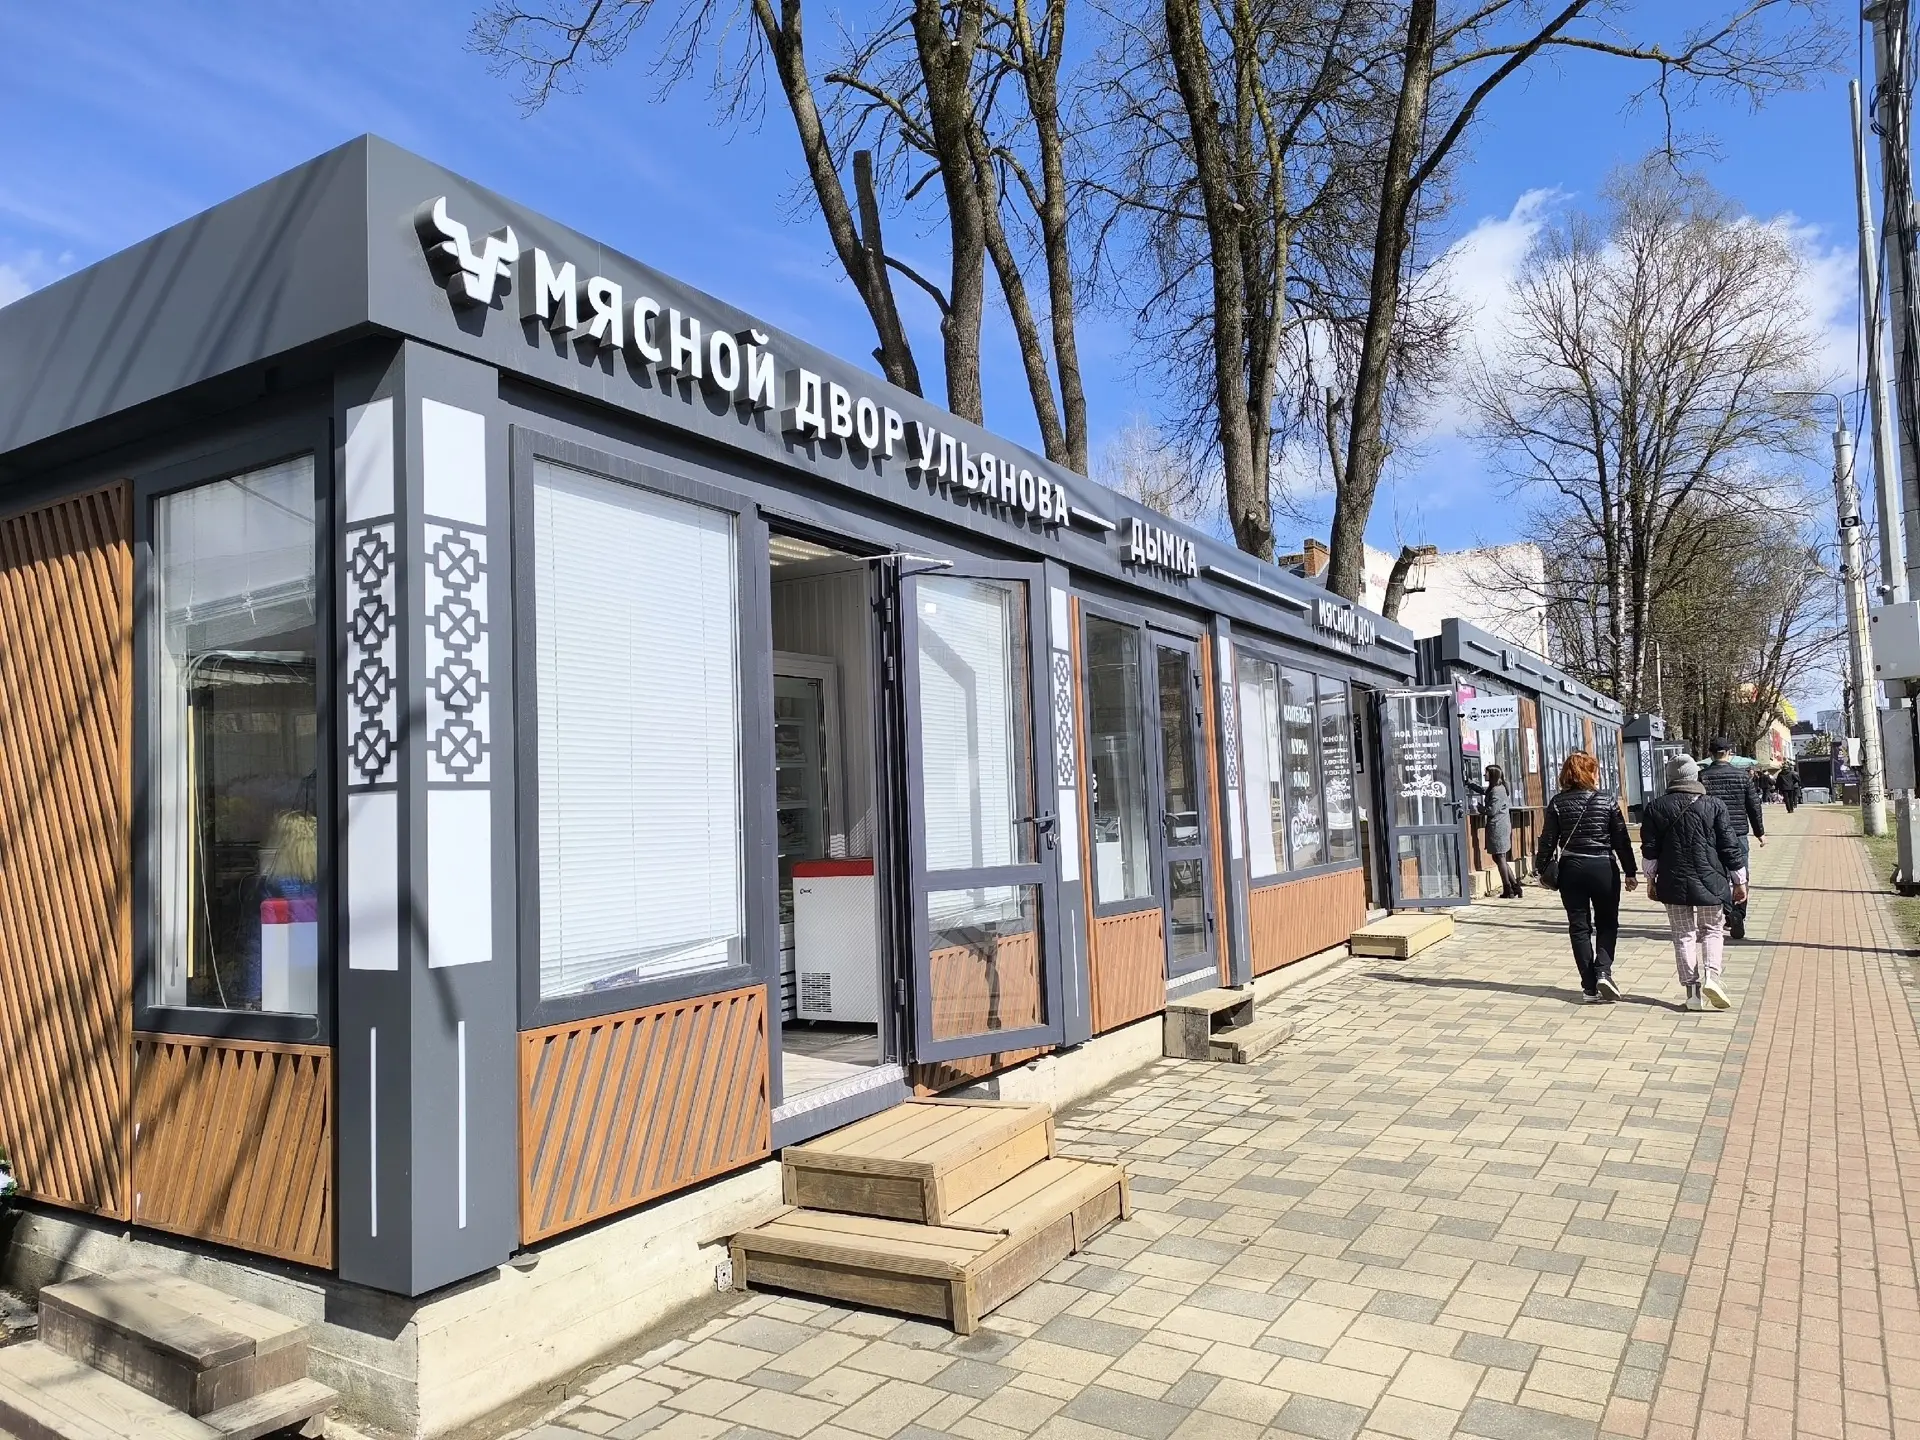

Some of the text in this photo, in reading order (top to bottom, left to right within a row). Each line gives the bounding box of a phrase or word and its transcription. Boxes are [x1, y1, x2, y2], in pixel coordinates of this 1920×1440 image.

[533, 247, 1070, 527] МЯСНОЙ ДВОР УЛЬЯНОВА
[1130, 517, 1199, 578] ДЫМКА
[1319, 597, 1376, 646] МЯСНОЙ ДОМ
